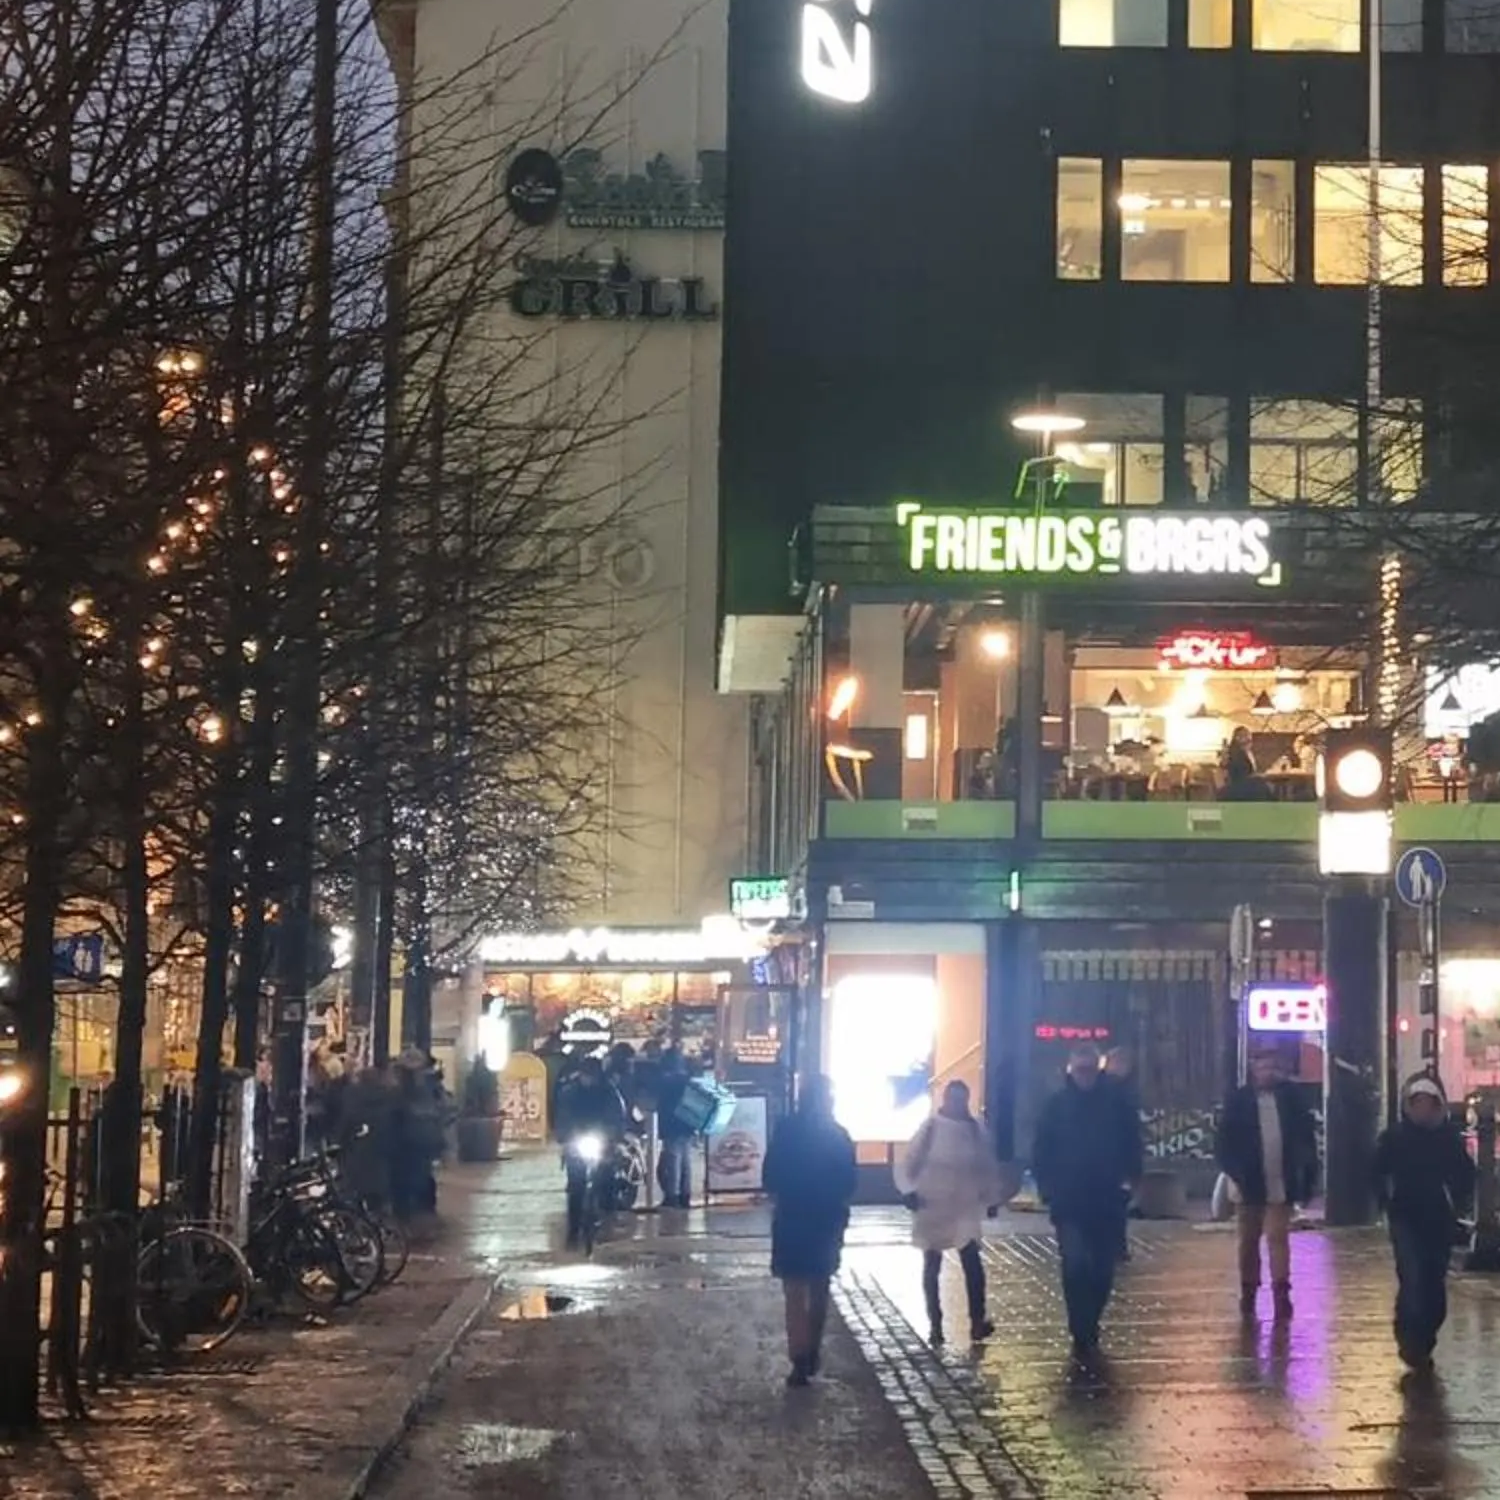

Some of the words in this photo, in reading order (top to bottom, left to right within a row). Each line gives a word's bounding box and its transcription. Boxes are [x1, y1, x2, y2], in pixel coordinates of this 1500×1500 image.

[910, 515, 1095, 571] FRIENDS
[1098, 517, 1124, 572] &
[1125, 516, 1270, 574] BRGRS
